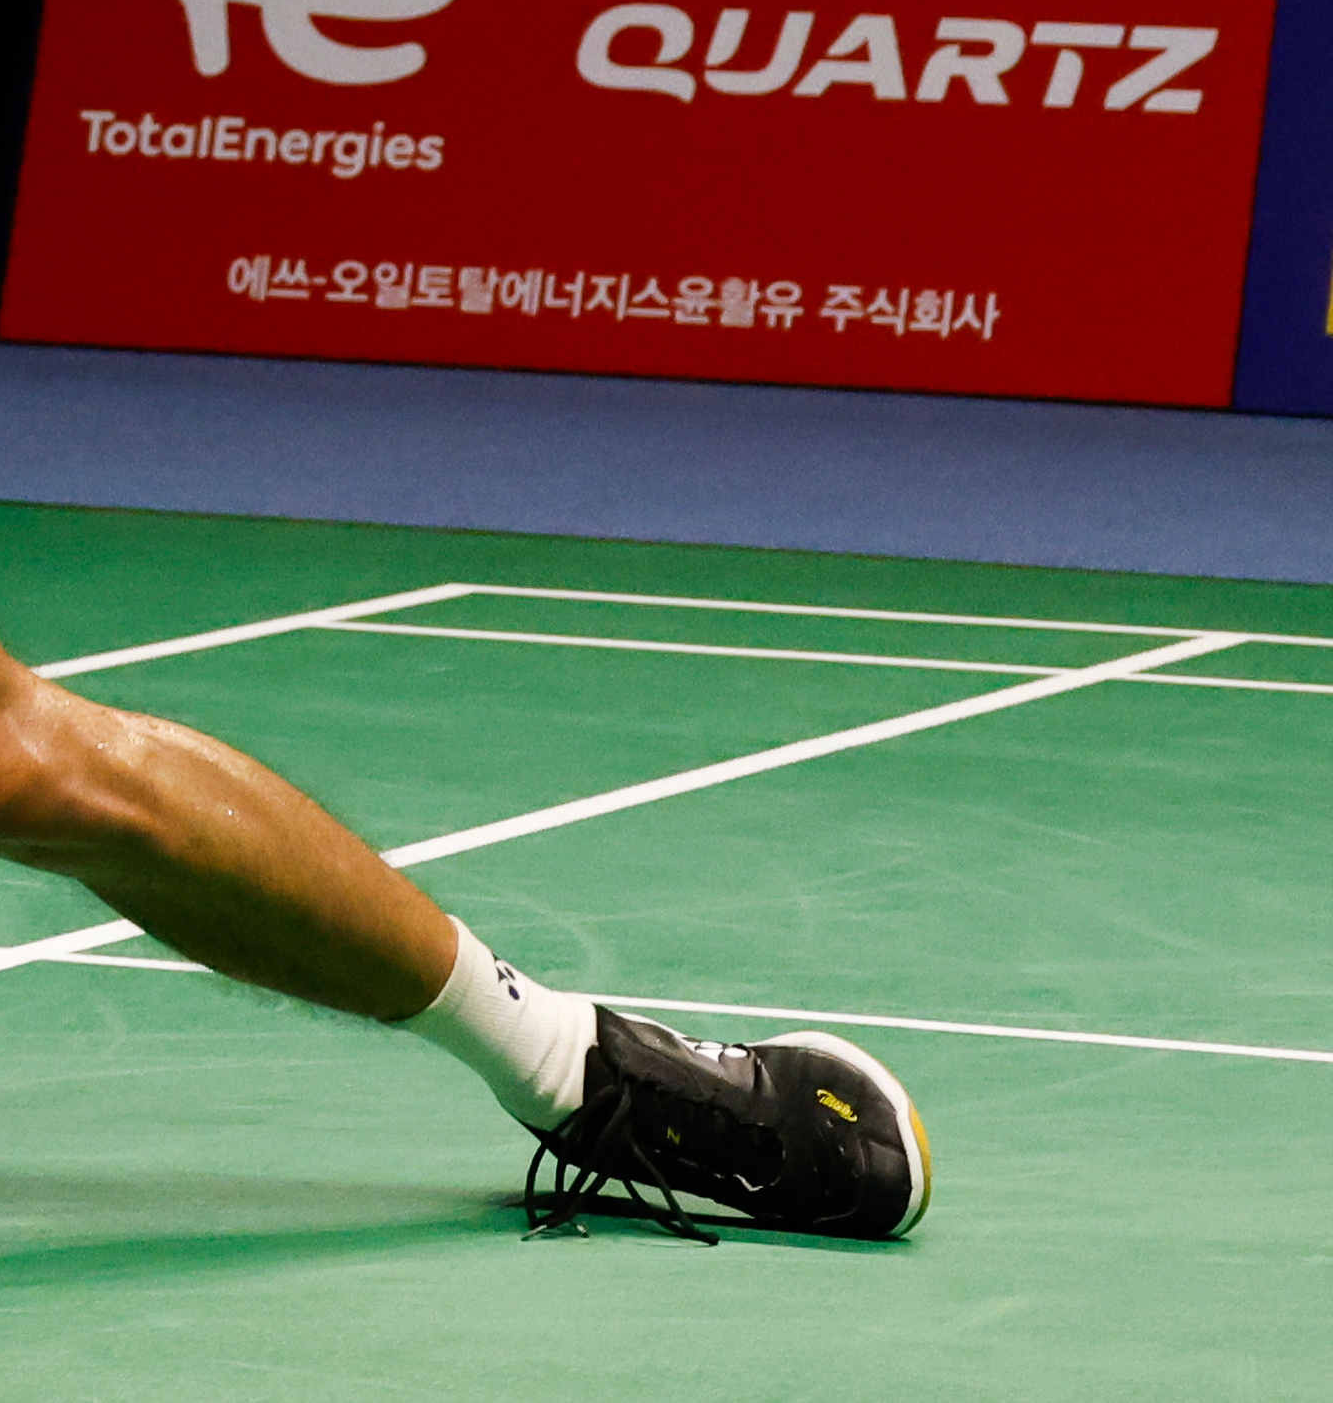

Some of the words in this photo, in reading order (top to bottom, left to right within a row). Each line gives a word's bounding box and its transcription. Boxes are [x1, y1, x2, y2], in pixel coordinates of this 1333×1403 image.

[575, 2, 1219, 113] QUARTZ
[79, 109, 445, 179] TotalEnergies
[819, 284, 1000, 340] 주식회사
